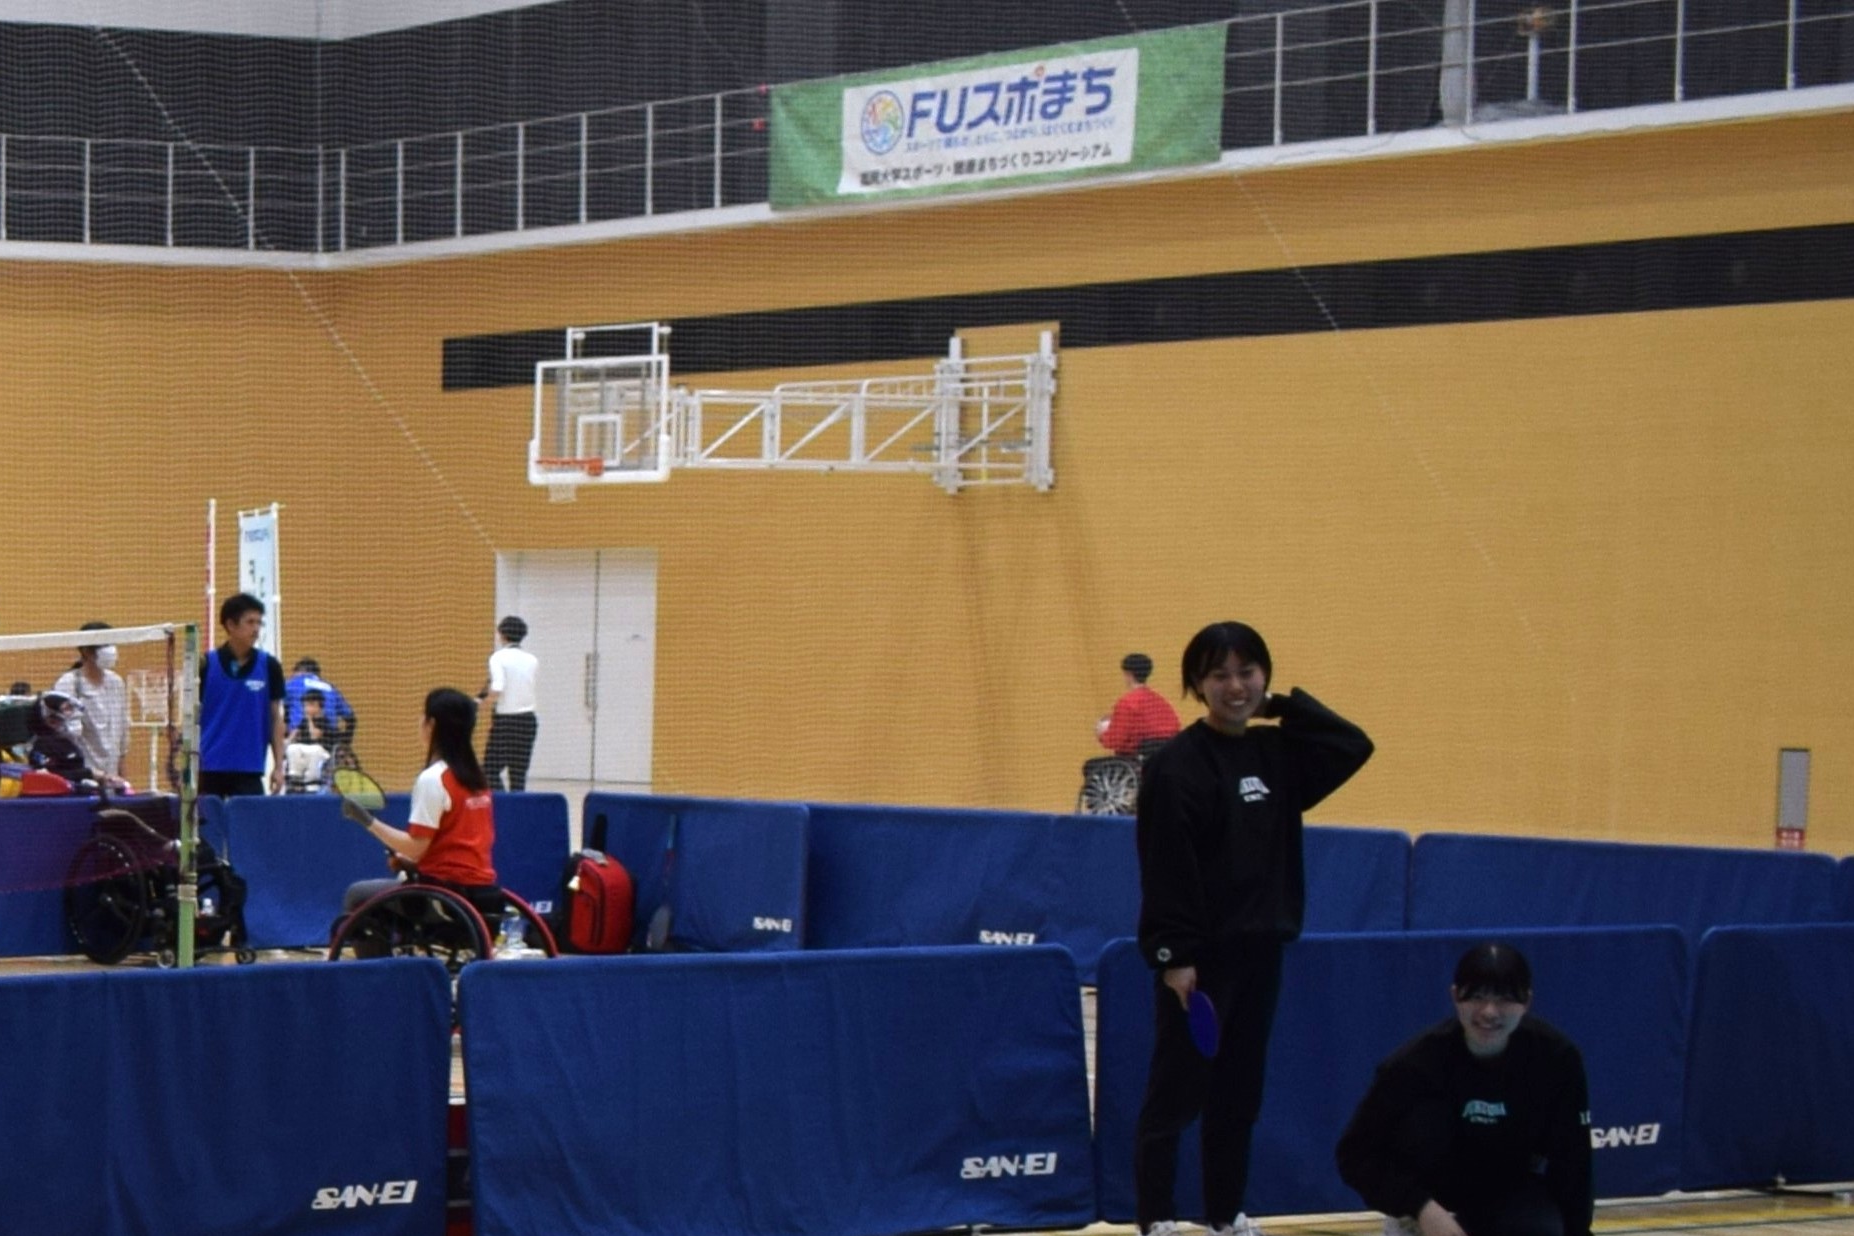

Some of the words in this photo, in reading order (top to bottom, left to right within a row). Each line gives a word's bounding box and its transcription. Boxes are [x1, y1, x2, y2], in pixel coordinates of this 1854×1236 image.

[907, 65, 1117, 138] FUスポまち
[960, 1152, 1057, 1179] SAN-EI
[311, 1180, 418, 1210] SAN-EI
